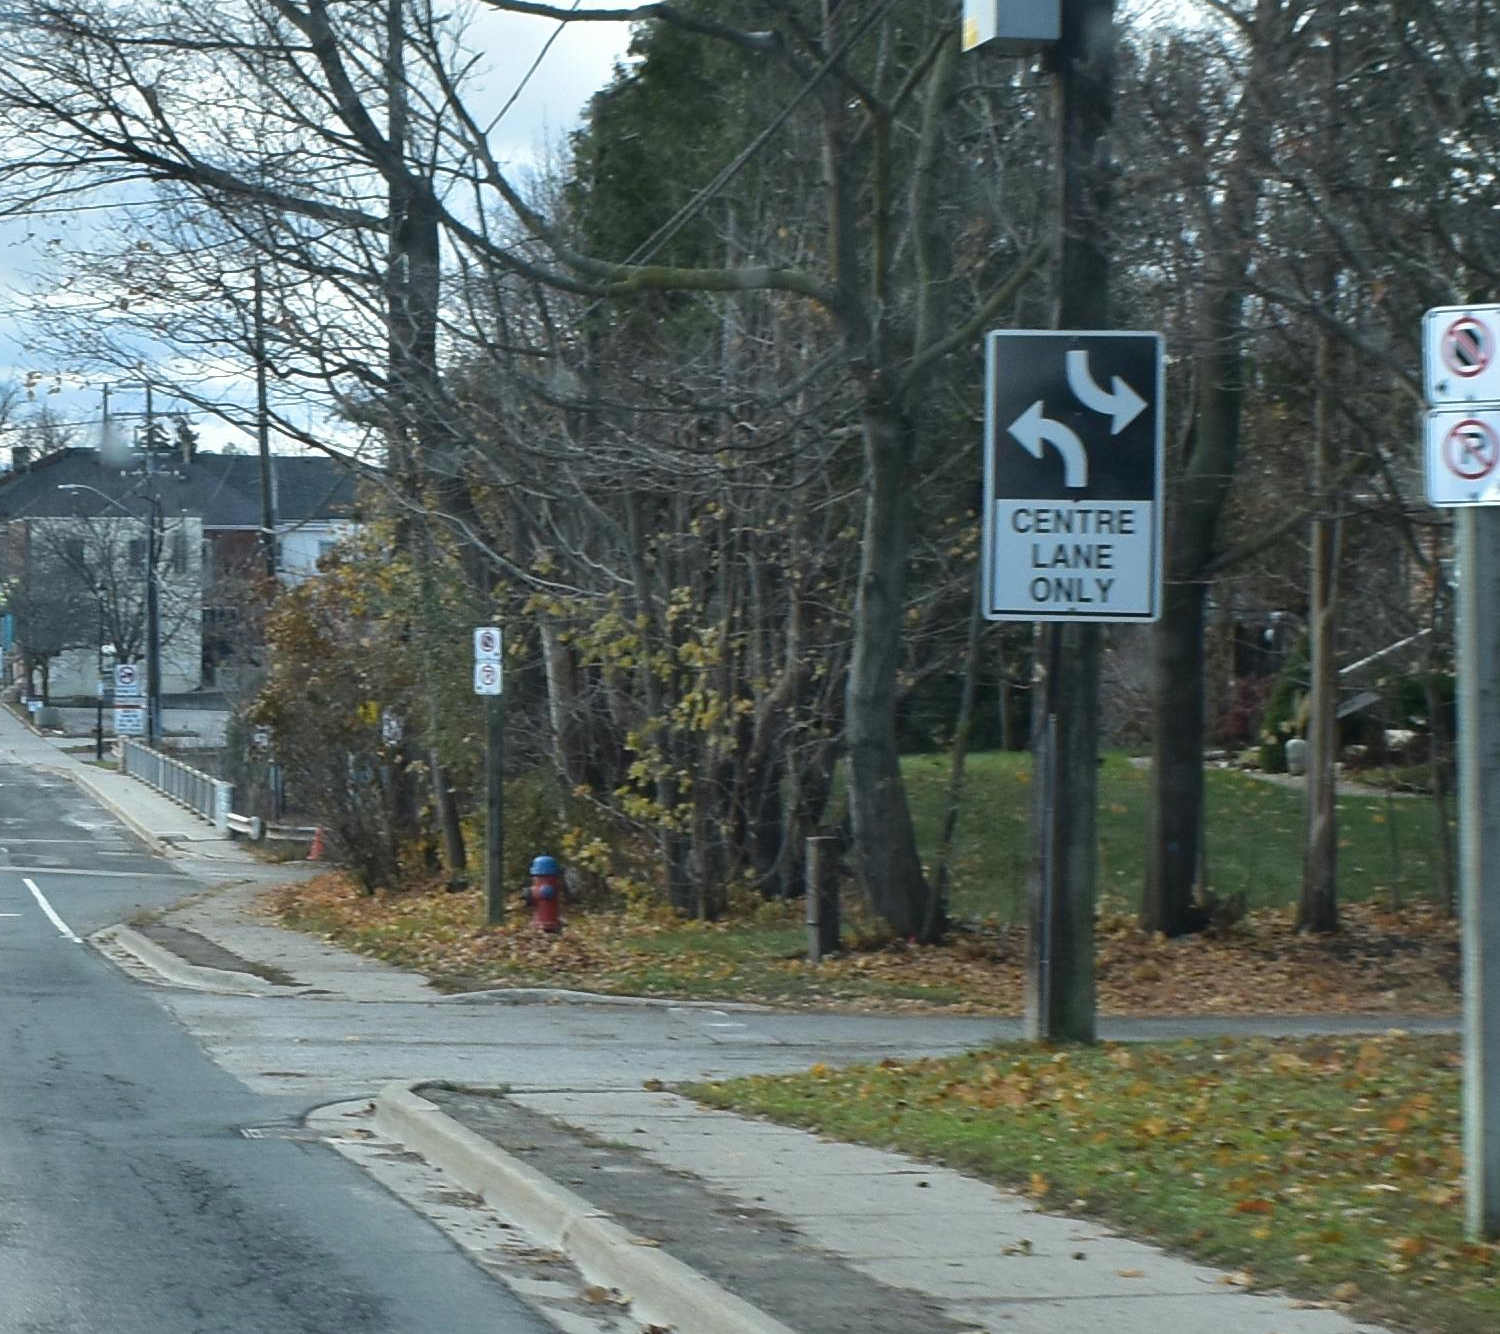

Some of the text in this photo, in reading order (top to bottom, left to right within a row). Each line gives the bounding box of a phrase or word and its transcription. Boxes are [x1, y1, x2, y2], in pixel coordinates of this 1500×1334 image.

[1011, 508, 1136, 535] CENTRE
[1031, 544, 1113, 569] LANE
[1030, 577, 1115, 603] ONLY
